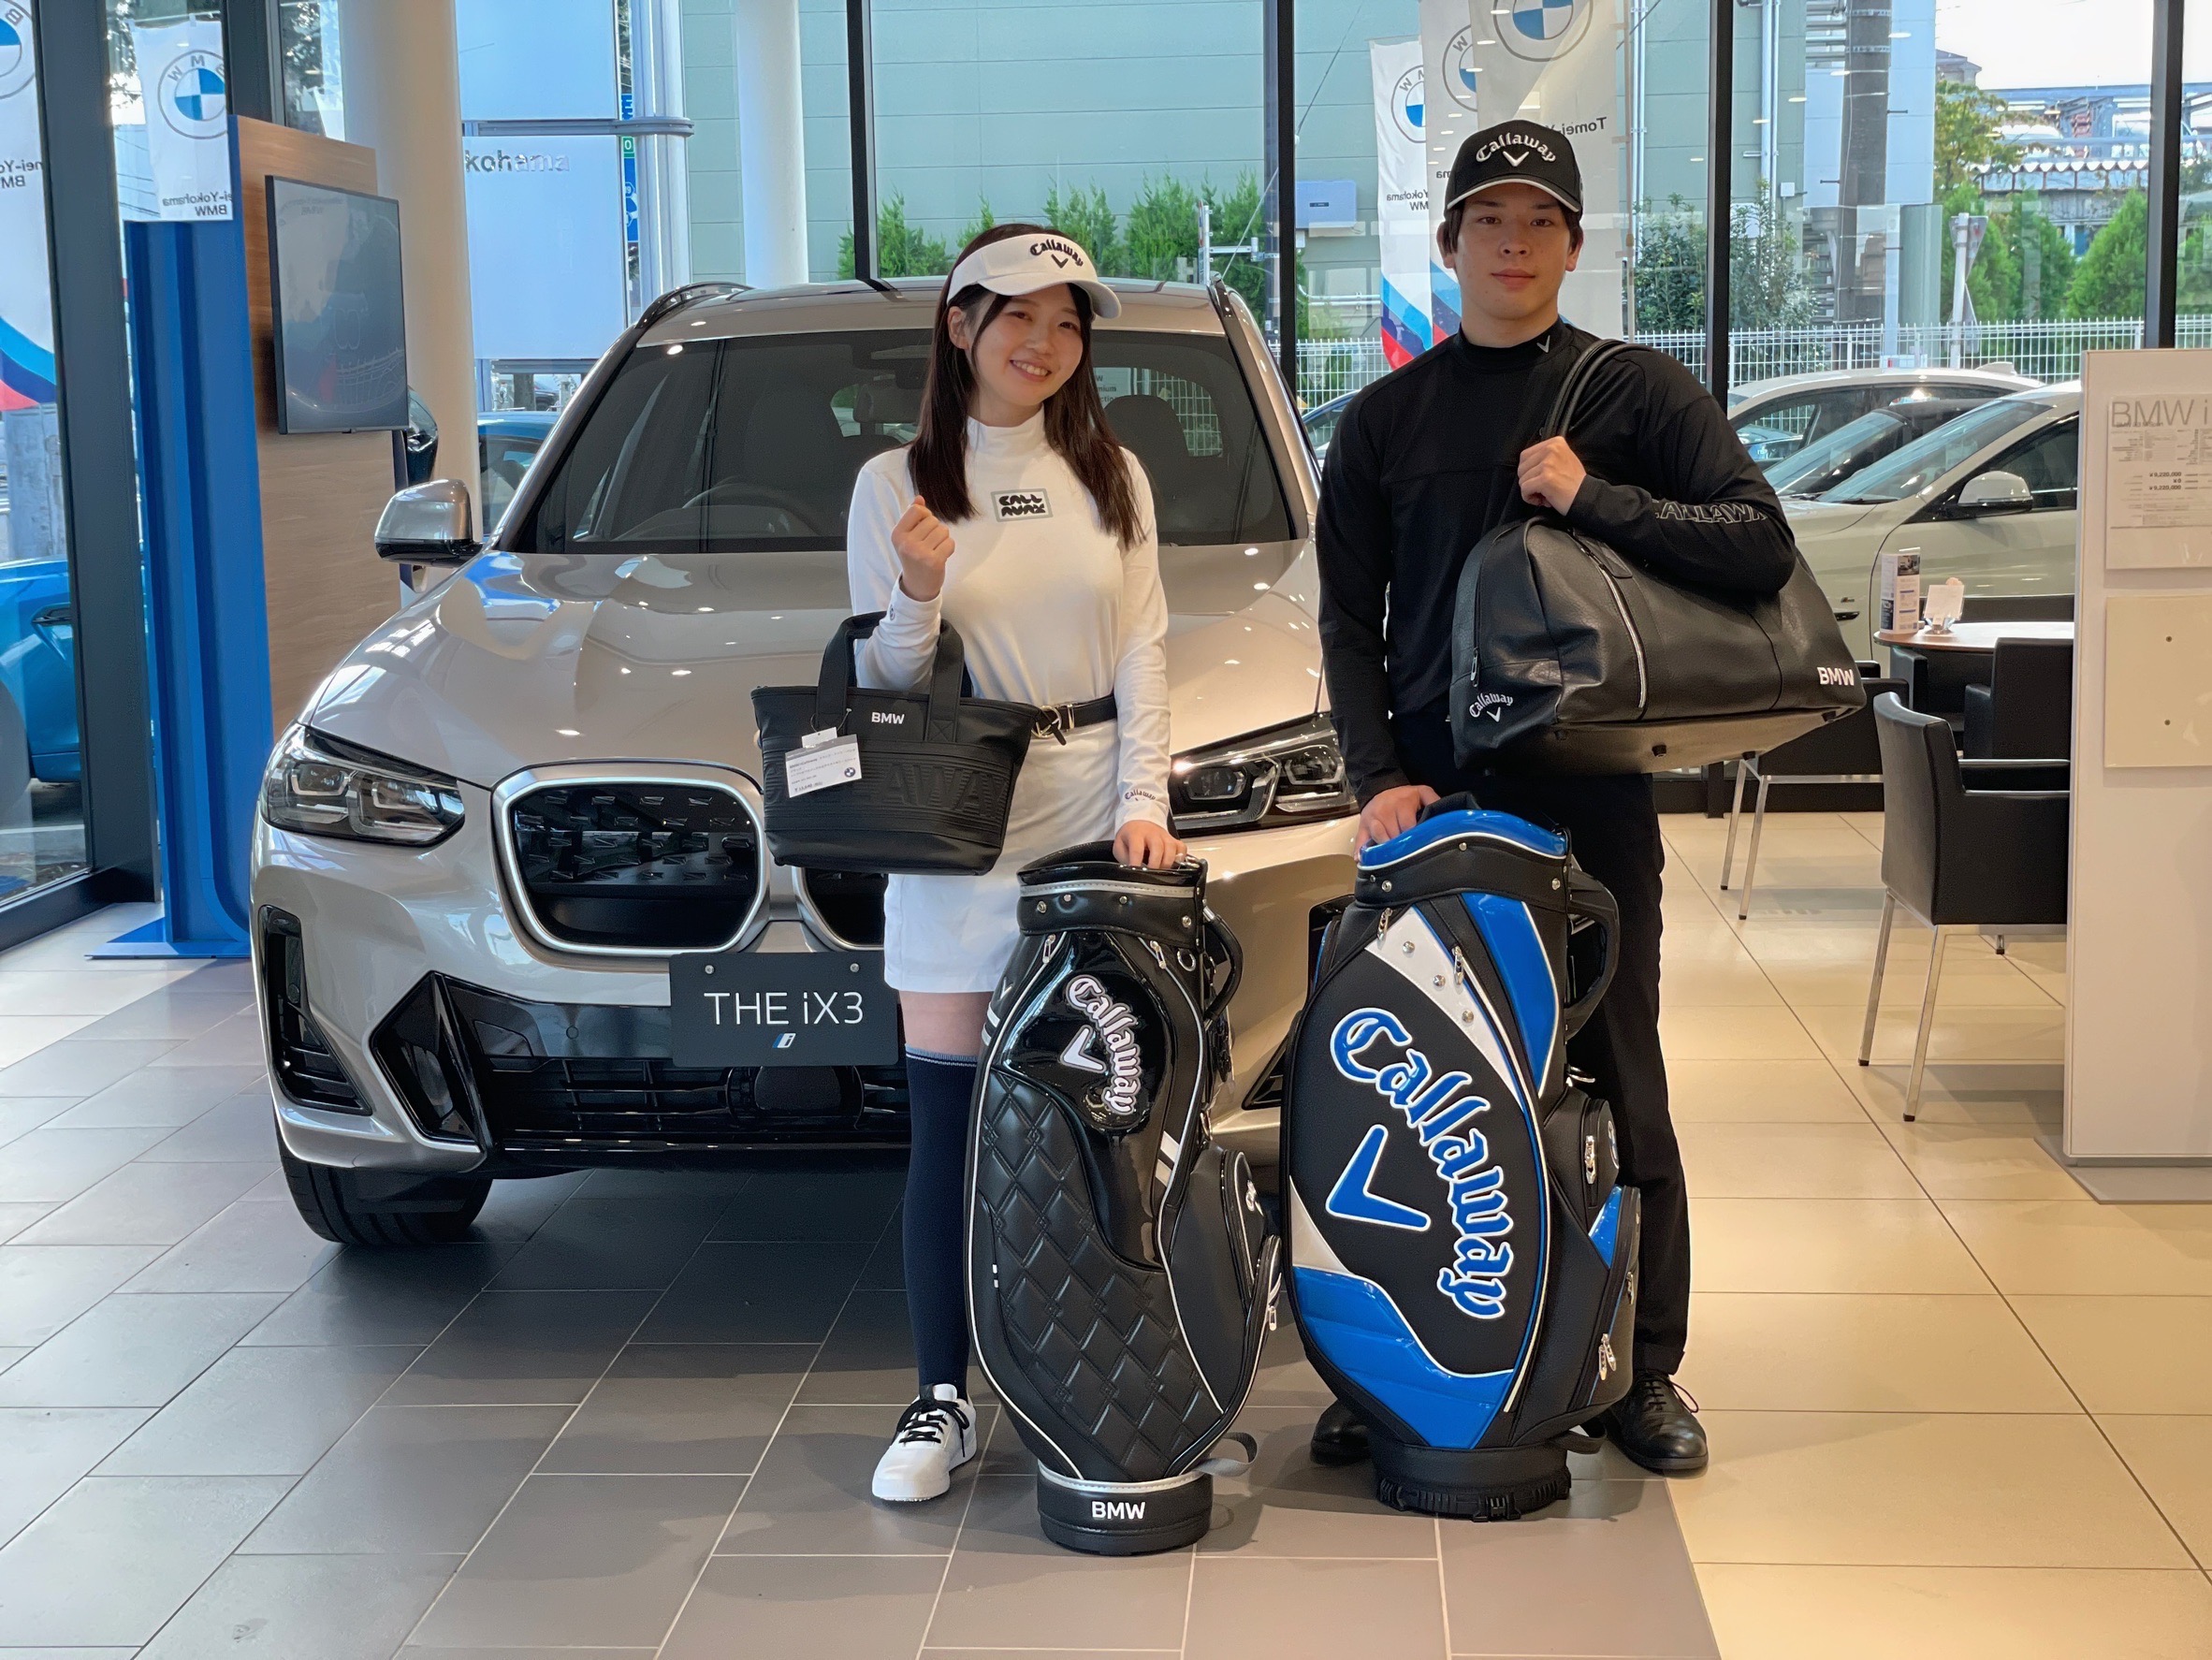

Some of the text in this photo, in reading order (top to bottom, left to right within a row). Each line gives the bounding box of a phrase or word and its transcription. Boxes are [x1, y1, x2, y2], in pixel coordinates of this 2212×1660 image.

[464, 150, 570, 172] kohama
[1476, 132, 1556, 163] Callaway
[1029, 239, 1084, 267] Callaway
[2111, 400, 2194, 428] BMW
[1817, 666, 1855, 687] BMW
[871, 711, 905, 725] BMW
[1469, 692, 1513, 718] Callaway
[1124, 789, 1156, 800] Callaway
[704, 992, 864, 1025] THE iX3
[1068, 976, 1141, 1114] Callaway
[1330, 1007, 1515, 1319] Callaway
[1091, 1501, 1146, 1520] BMW
